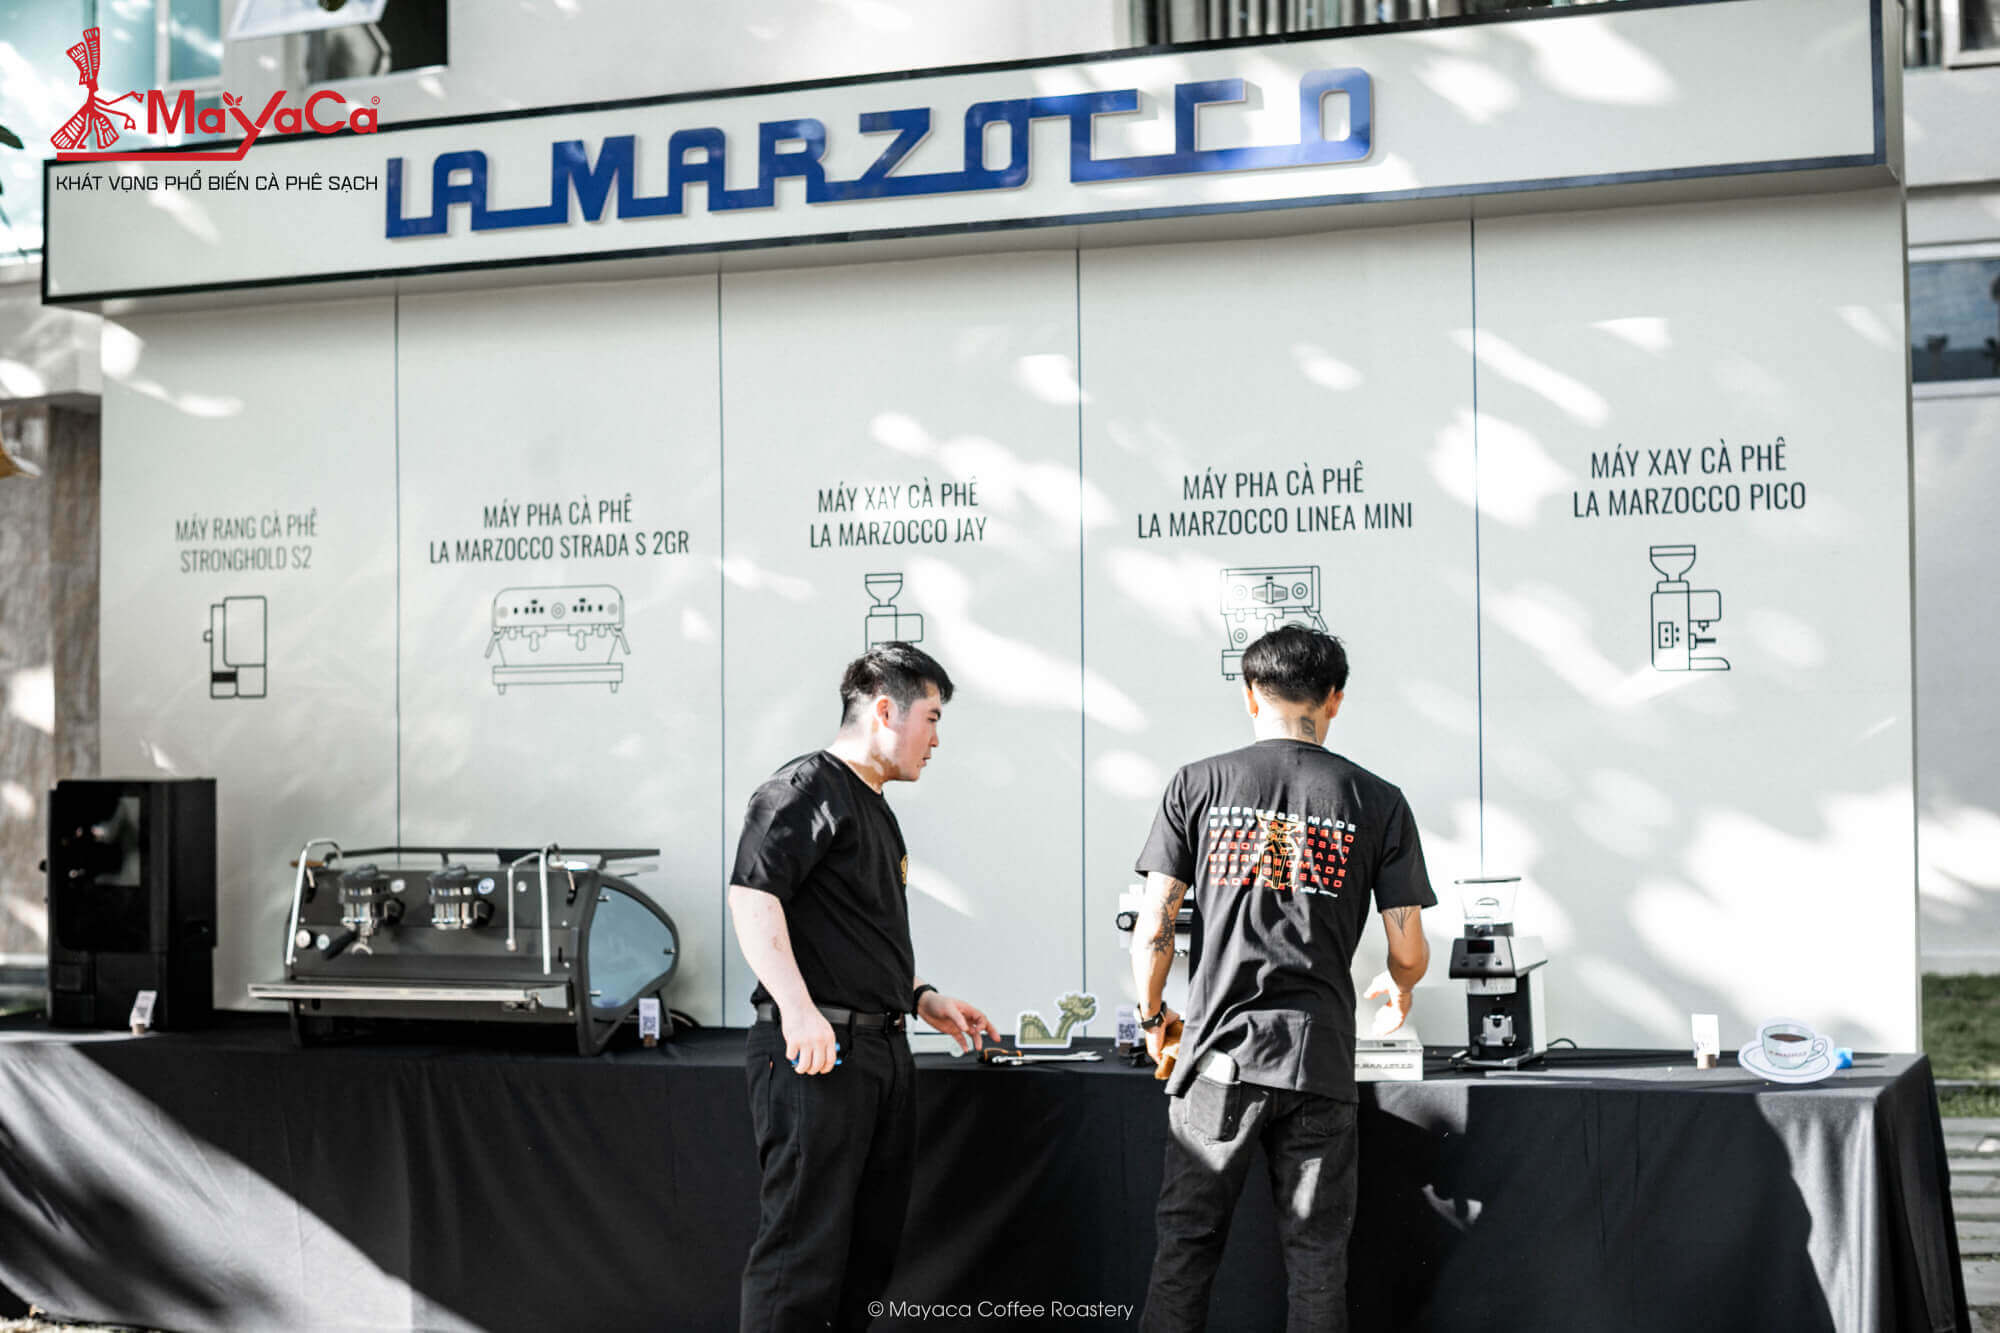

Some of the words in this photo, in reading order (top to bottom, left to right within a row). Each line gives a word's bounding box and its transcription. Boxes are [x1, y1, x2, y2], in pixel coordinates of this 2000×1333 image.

[386, 150, 488, 239] LA
[550, 67, 1373, 224] MARZOCCO
[1592, 443, 1639, 479] MÁY
[1648, 448, 1691, 476] XAY
[1701, 439, 1732, 474] CÀ
[1741, 436, 1786, 472] PHÊ
[818, 481, 857, 512] MÁY
[865, 485, 900, 510] XAY
[908, 477, 933, 508] CÀ
[941, 476, 978, 507] PHÊ
[1184, 467, 1227, 500] MÁY
[1236, 472, 1278, 498] PHA
[1287, 462, 1314, 496] CÀ
[1323, 460, 1363, 494] PHÊ
[484, 499, 520, 528] MÁY
[527, 503, 562, 527] PHA
[569, 495, 592, 525] CÀ
[599, 493, 632, 524] PHÊ
[1574, 491, 1599, 517] LA
[1609, 485, 1740, 516] MARZOCCO
[1750, 482, 1805, 511] PICO
[176, 514, 208, 541] MÁY
[213, 516, 256, 540] RANG
[260, 510, 282, 539] CÀ
[287, 507, 317, 537] PHÊ
[811, 523, 831, 548] LA
[839, 519, 947, 546] MARZOCCO
[954, 517, 987, 543] JAY
[1138, 513, 1161, 539] LA
[1170, 508, 1287, 537] MARZOCCO
[1297, 505, 1355, 532] LINEA
[1365, 502, 1411, 529] MINI
[180, 546, 287, 574] STRONGHOLD
[291, 545, 312, 570] S2
[430, 541, 449, 564] LA
[456, 536, 553, 562] MARZOCCO
[560, 533, 629, 559] STRADA
[635, 532, 646, 556] S
[653, 530, 689, 555] 2GR
